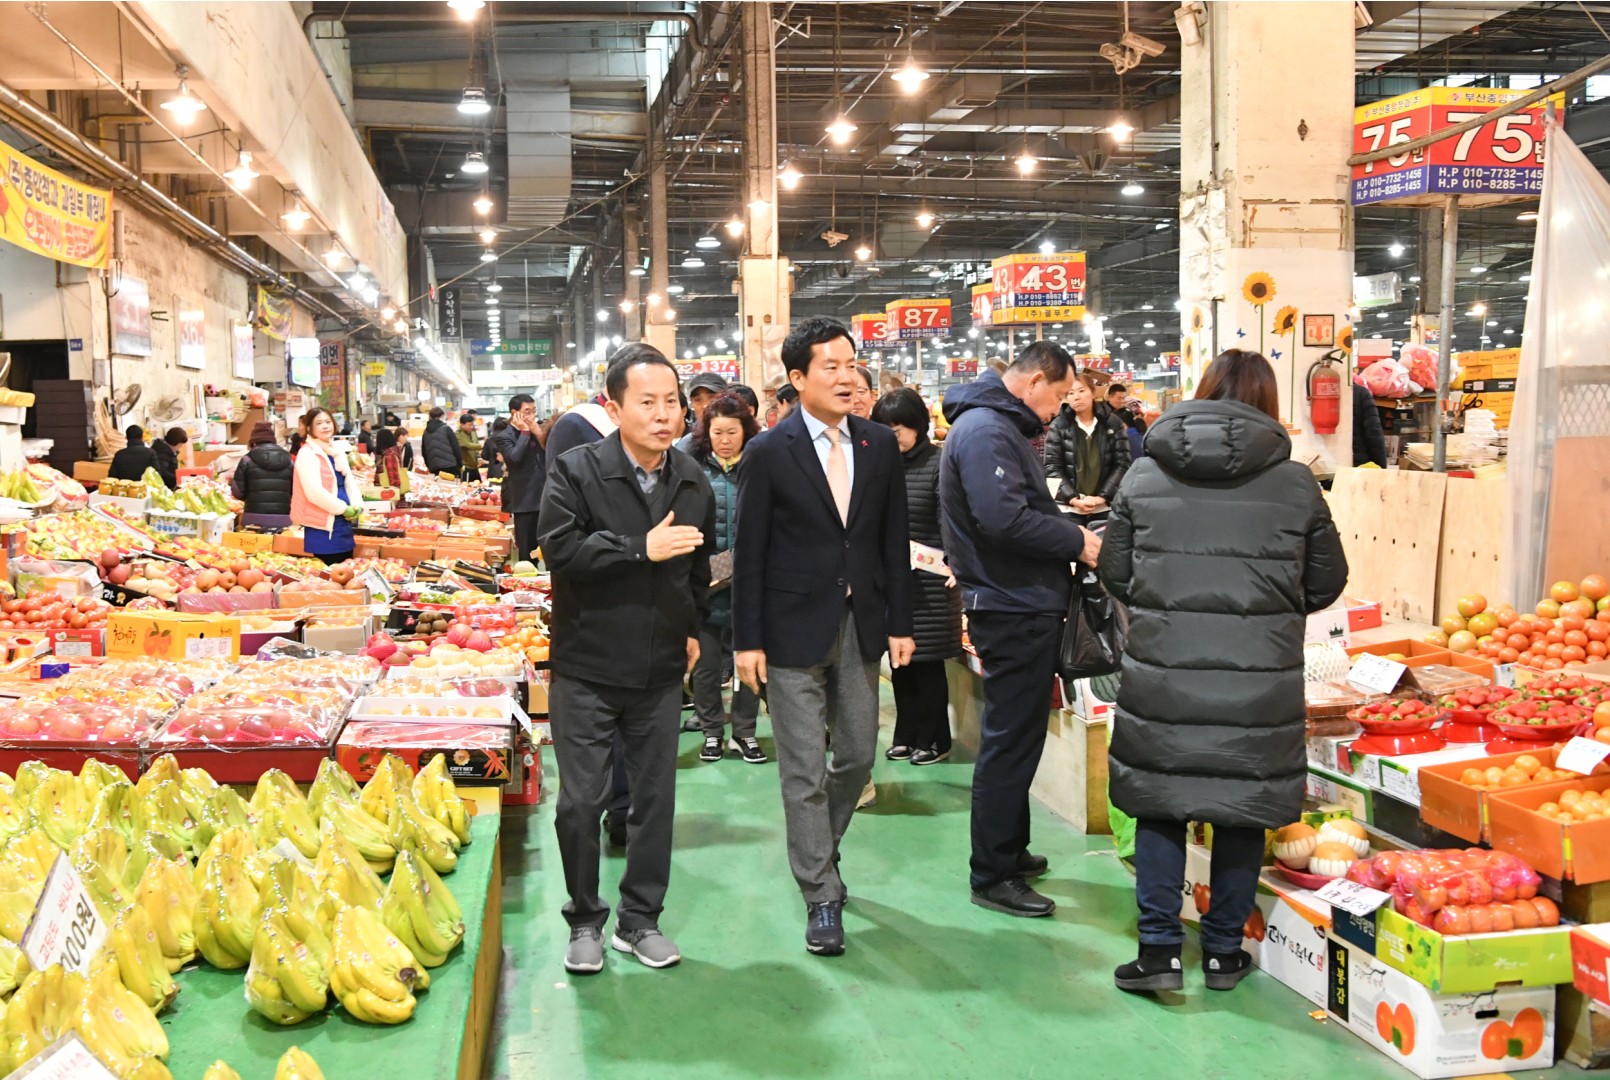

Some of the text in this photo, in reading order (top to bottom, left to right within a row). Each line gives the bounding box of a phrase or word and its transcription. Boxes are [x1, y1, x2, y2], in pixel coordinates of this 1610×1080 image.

[1370, 168, 1422, 187] 010-7732-1456
[1438, 167, 1543, 179] H.P 010-7732-145
[1369, 180, 1421, 198] 010-8285-1455
[1438, 178, 1542, 190] H.P 010-8285-145
[320, 344, 339, 366] 9번
[1335, 949, 1347, 1006] 대봉감
